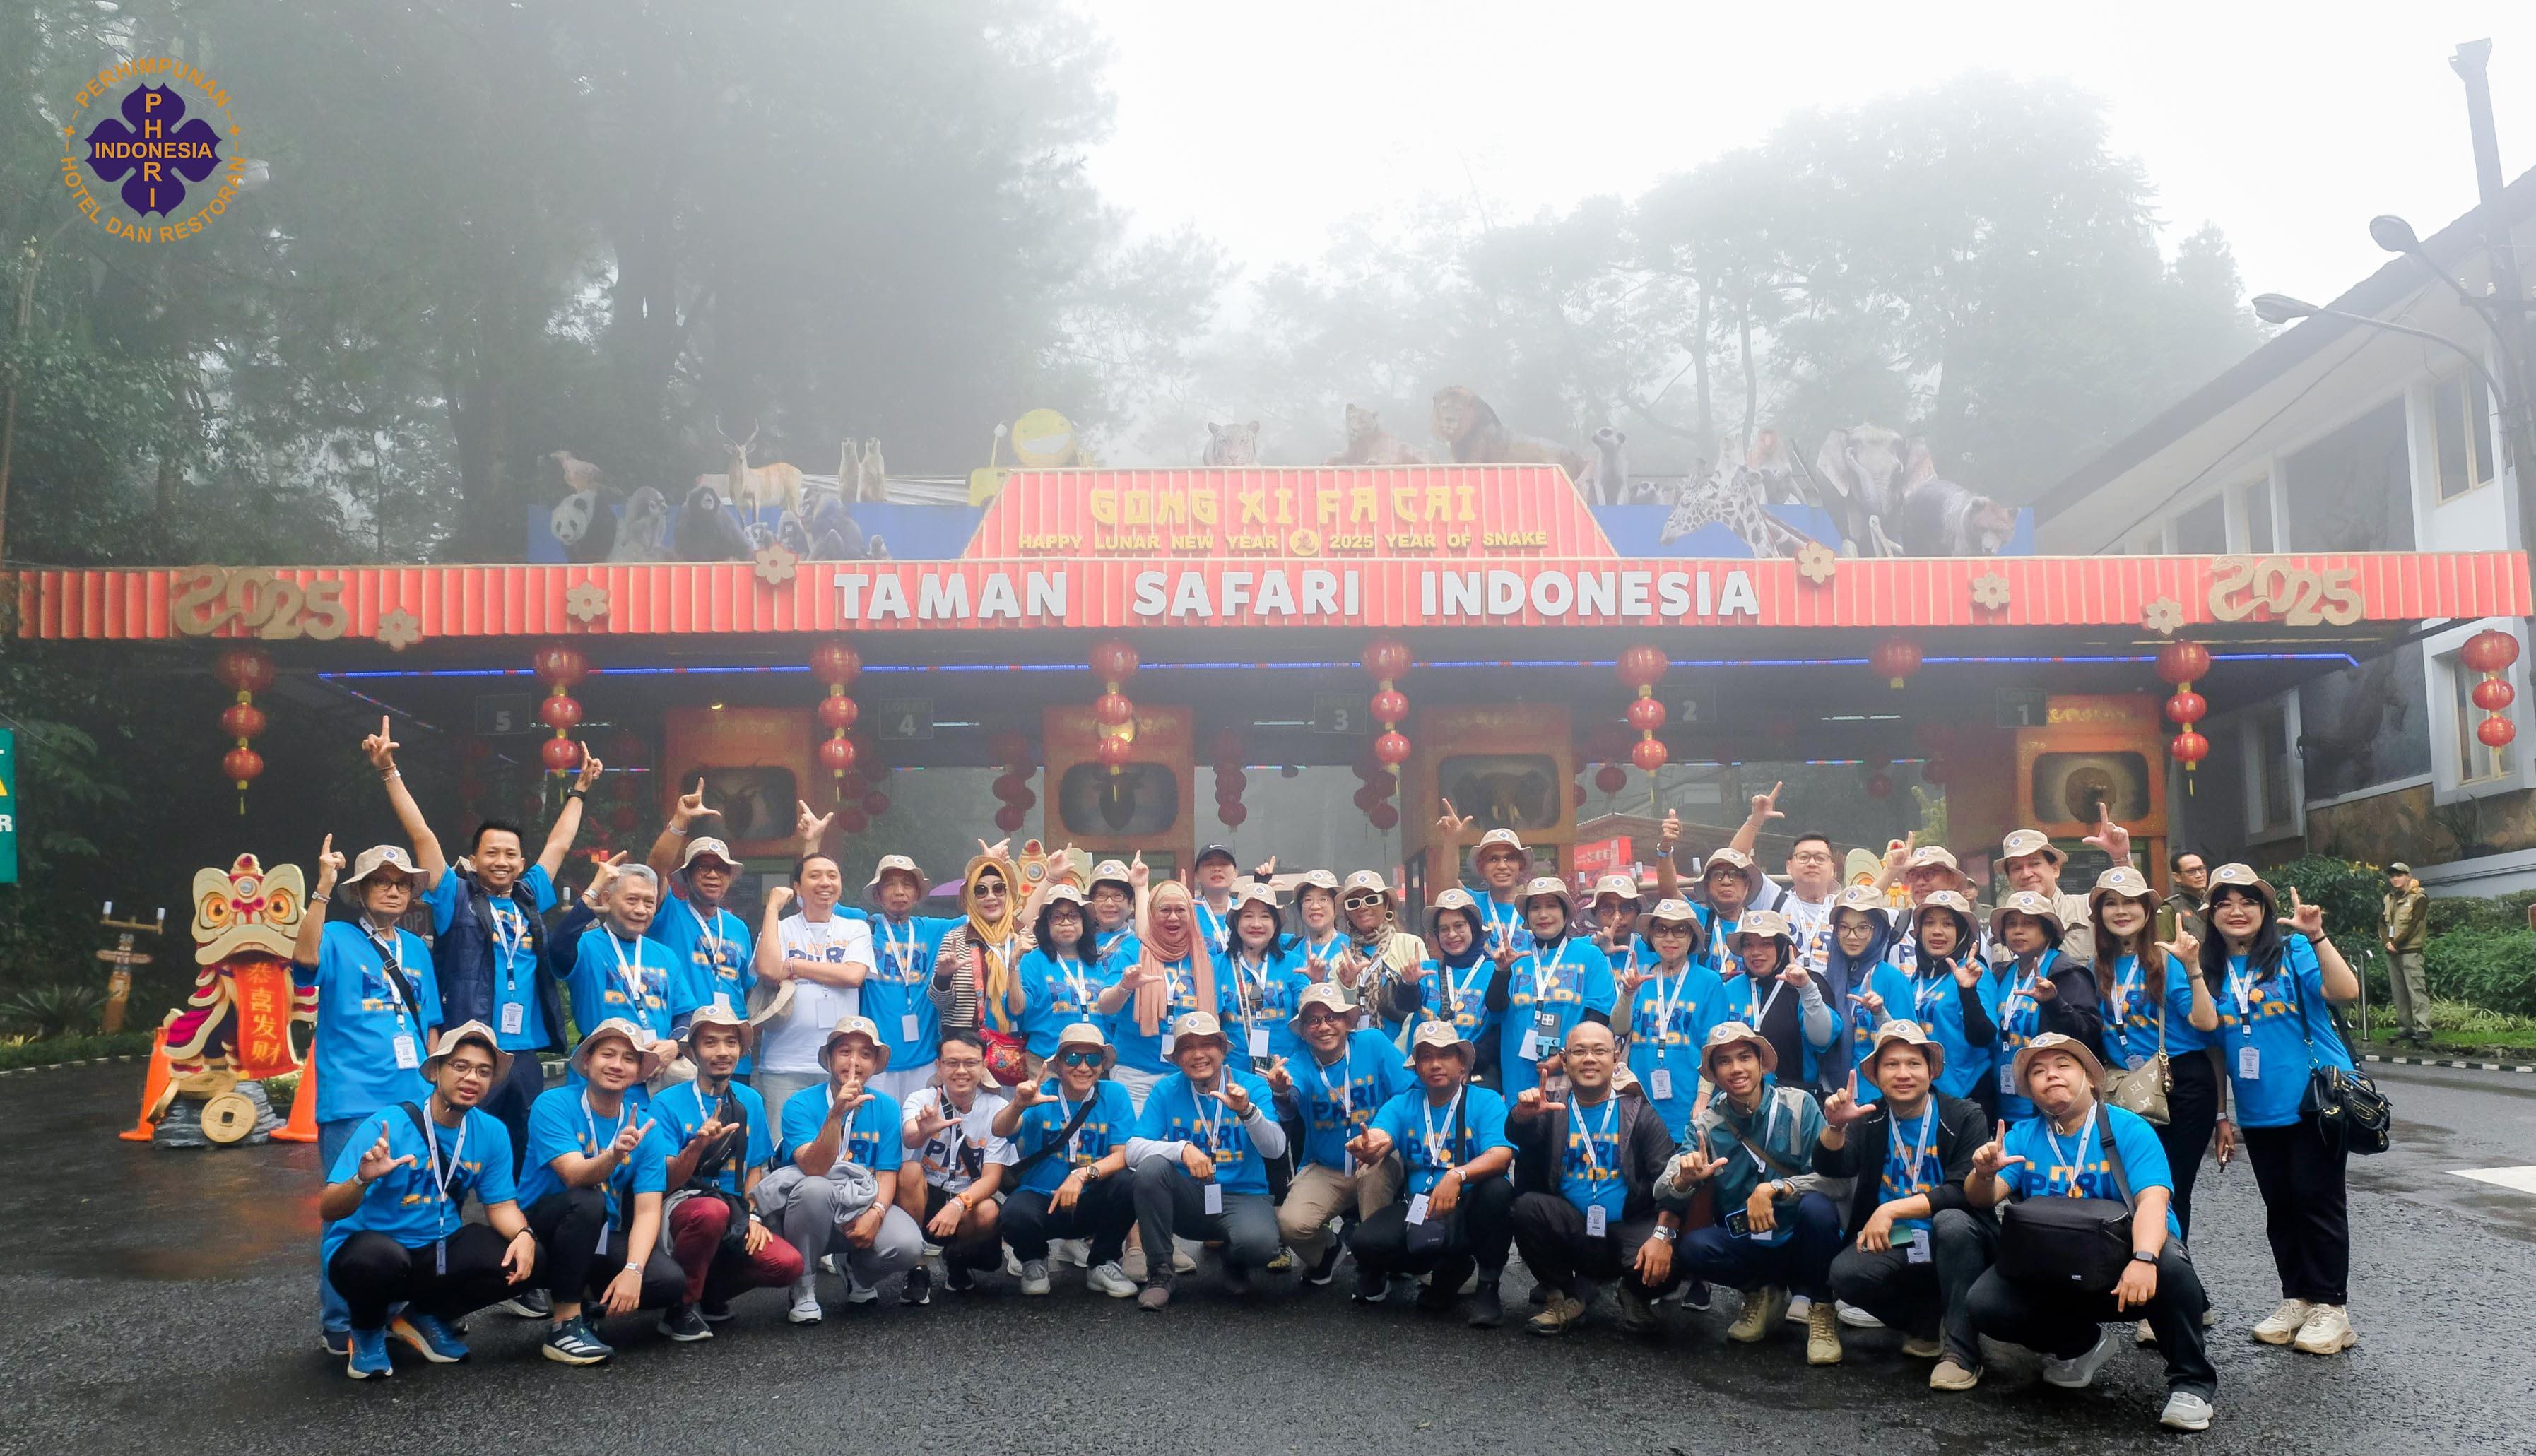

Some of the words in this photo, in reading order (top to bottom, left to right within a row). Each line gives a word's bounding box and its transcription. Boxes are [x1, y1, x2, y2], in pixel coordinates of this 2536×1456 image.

[1090, 487, 1218, 526] GONG
[1240, 487, 1292, 526] XI
[1318, 487, 1378, 526] FA
[1394, 485, 1475, 523] CAI
[1019, 534, 1083, 551] HAPPY
[1095, 533, 1160, 550] LUNAR
[1171, 533, 1215, 550] NEW
[1226, 533, 1278, 550] YEAR
[1328, 533, 1375, 550] 2025
[1385, 532, 1437, 549] YEAR
[1446, 532, 1472, 548] OF
[1482, 531, 1548, 547] SNAKE
[834, 572, 1067, 620] TAMAN
[1132, 570, 1359, 617] SAFARI
[1420, 570, 1759, 616] INDONESIA
[2207, 555, 2364, 626] 2025
[174, 564, 348, 641] 2025
[1333, 709, 1349, 730] 3
[1683, 700, 1697, 721] 2
[2018, 704, 2029, 726] 1
[495, 711, 512, 733] 5
[898, 714, 916, 736] 4
[246, 963, 282, 1065] 恭喜发财
